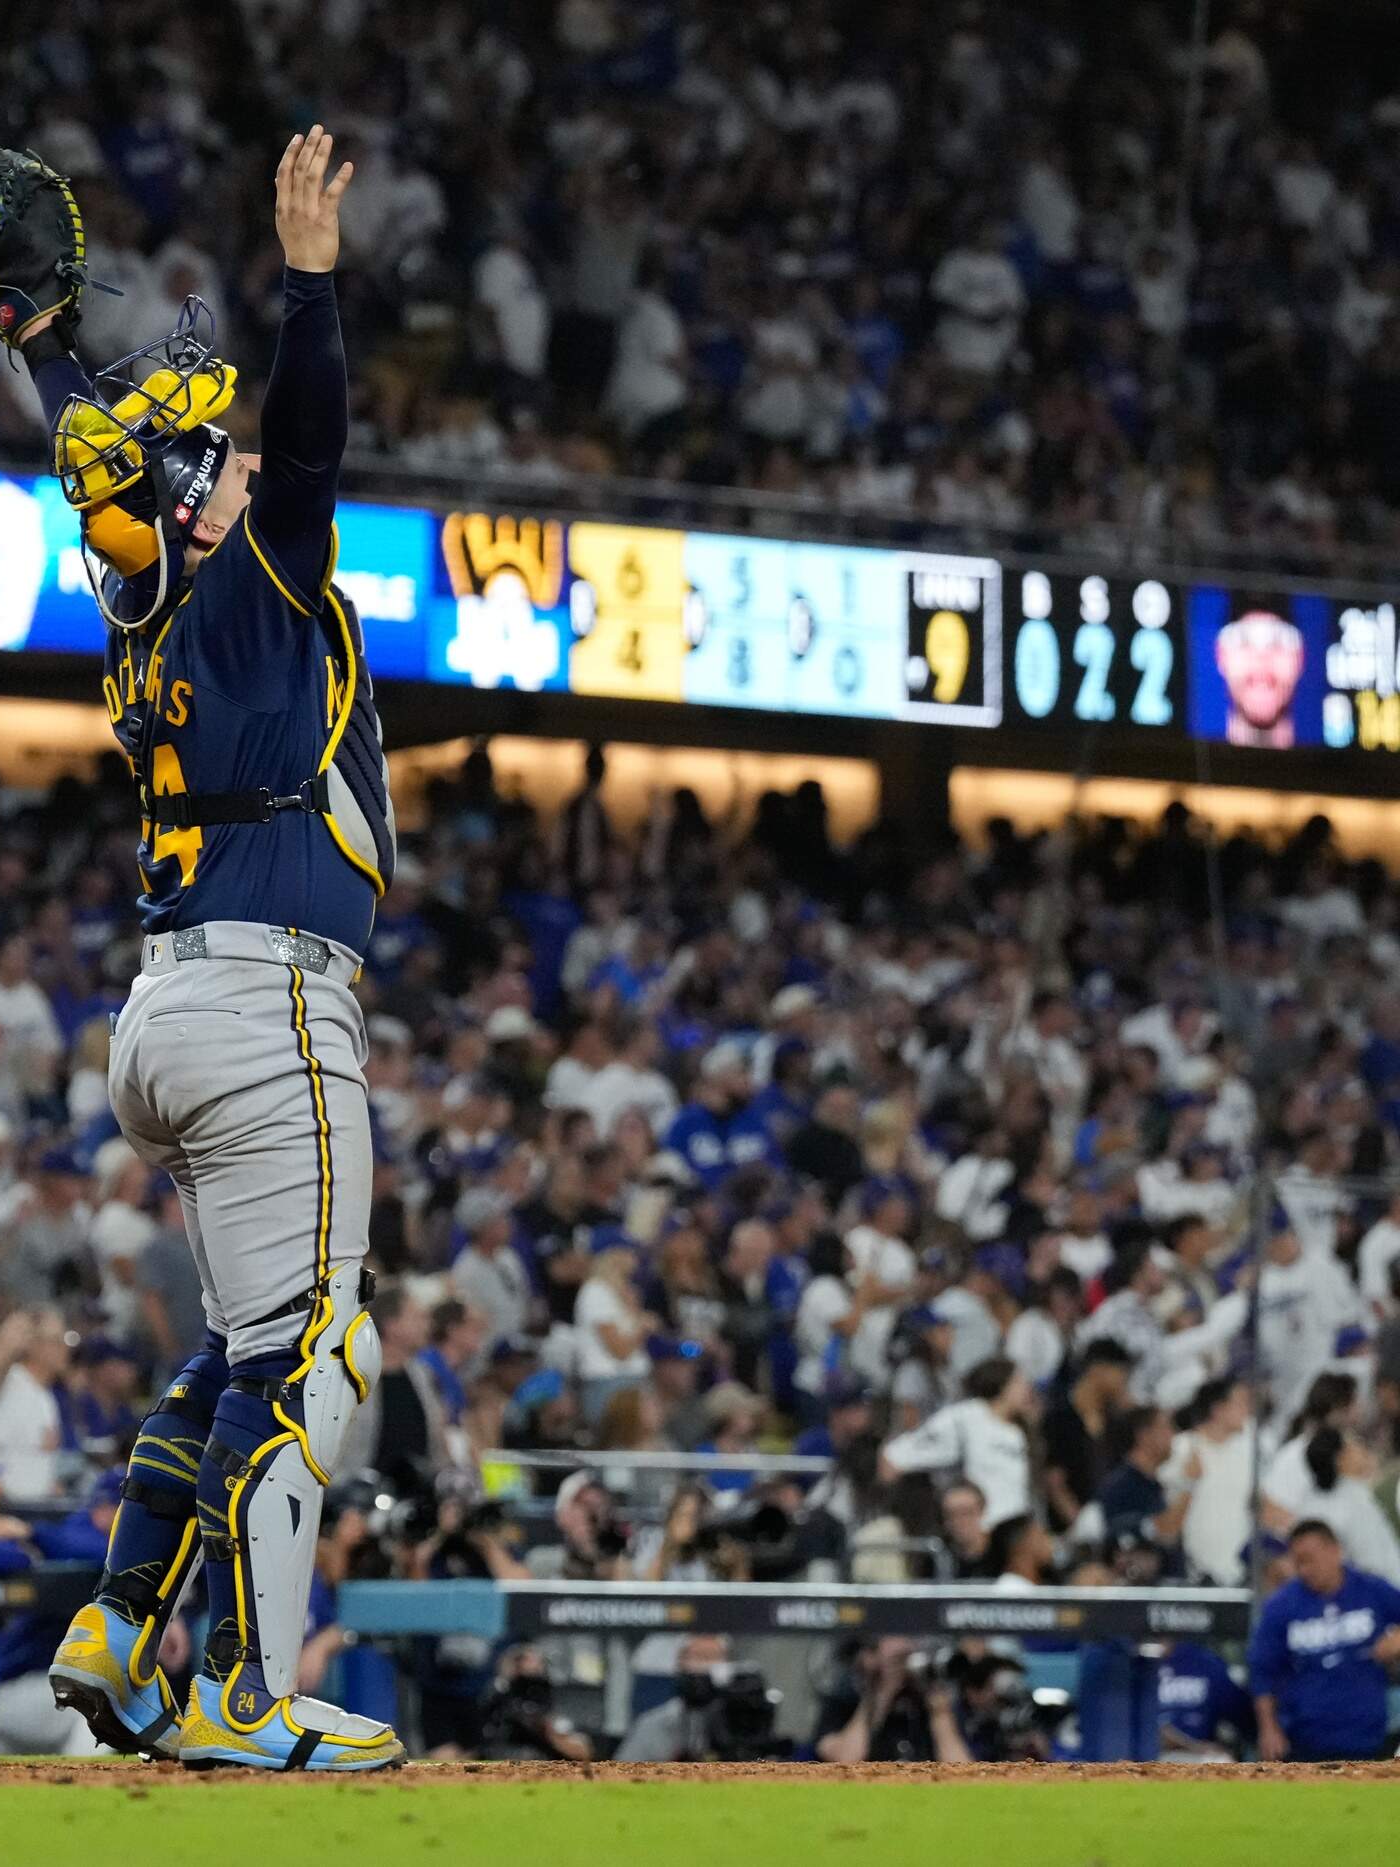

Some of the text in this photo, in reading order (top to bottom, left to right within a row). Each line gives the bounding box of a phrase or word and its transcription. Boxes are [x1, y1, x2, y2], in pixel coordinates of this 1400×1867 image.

[184, 447, 217, 507] STRAUSS
[619, 548, 644, 597] 6
[616, 629, 645, 678] 4
[925, 610, 969, 704] 9
[1015, 619, 1173, 725] 0 2 2
[237, 1691, 255, 1714] 24
